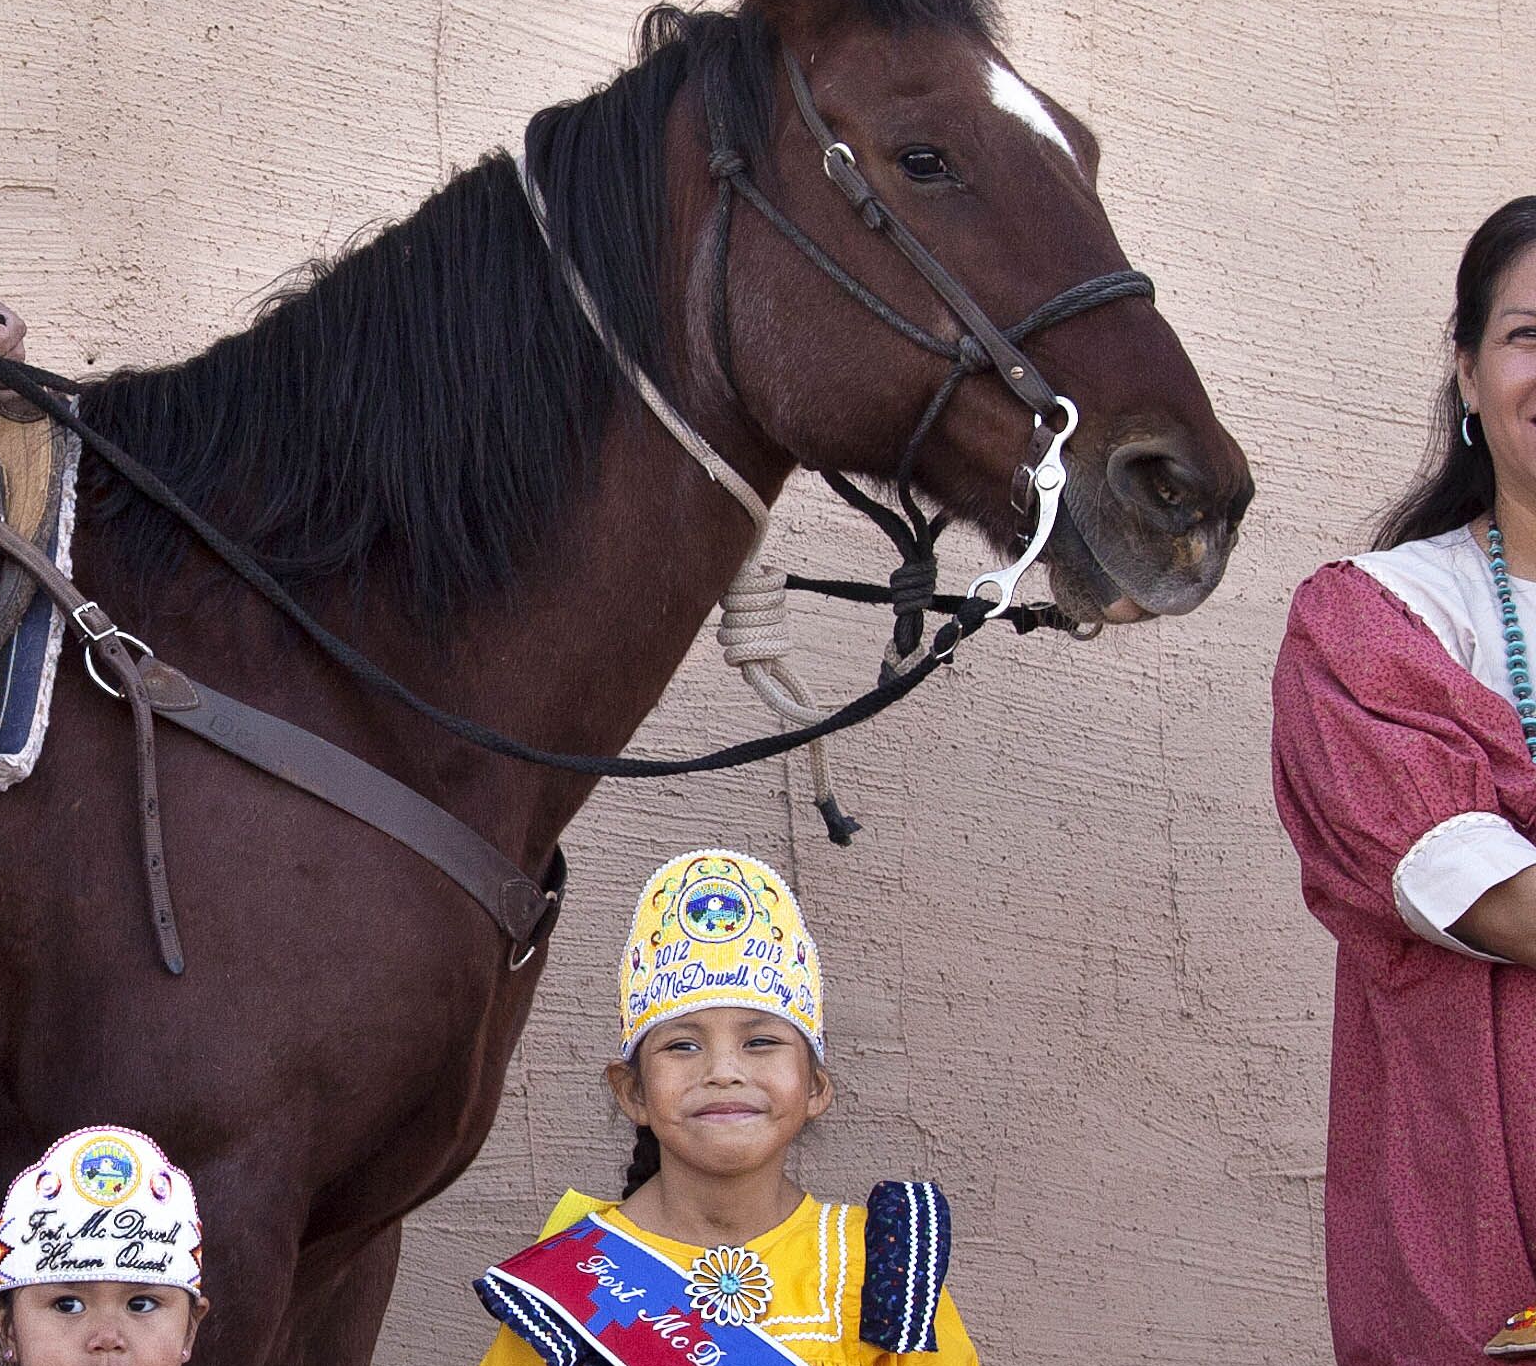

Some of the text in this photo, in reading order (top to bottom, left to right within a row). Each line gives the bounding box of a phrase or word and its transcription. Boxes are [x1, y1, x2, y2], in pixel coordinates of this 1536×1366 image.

[655, 938, 783, 969] 2012 2013
[650, 961, 749, 1003] McDowell
[754, 966, 793, 1007] Tiny
[21, 1208, 67, 1244] Fort
[576, 1255, 646, 1303] Fort
